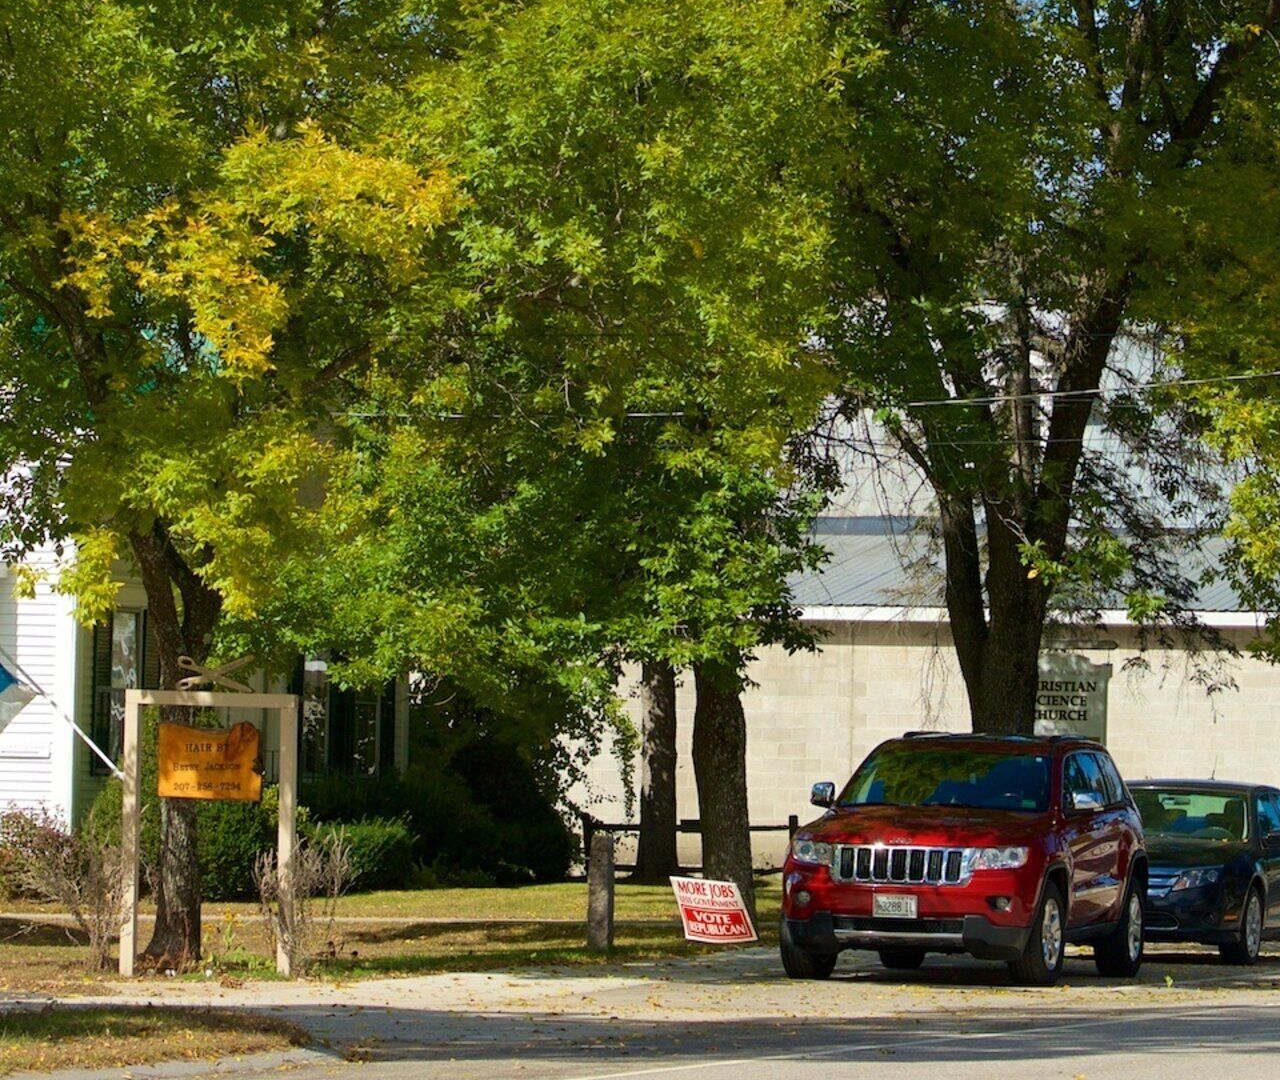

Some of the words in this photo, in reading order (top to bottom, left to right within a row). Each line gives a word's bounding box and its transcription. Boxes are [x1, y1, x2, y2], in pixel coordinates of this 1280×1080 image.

[1038, 680, 1097, 693] RISTIAN
[1036, 695, 1088, 707] CIENCE
[1034, 709, 1088, 721] HURCH
[185, 743, 212, 753] HAIR
[677, 880, 708, 897] MORE
[709, 883, 735, 899] JOBS
[693, 897, 739, 907] GOVERNMENT
[692, 910, 733, 924] VOTE
[688, 920, 746, 935] REPUBLICAN
